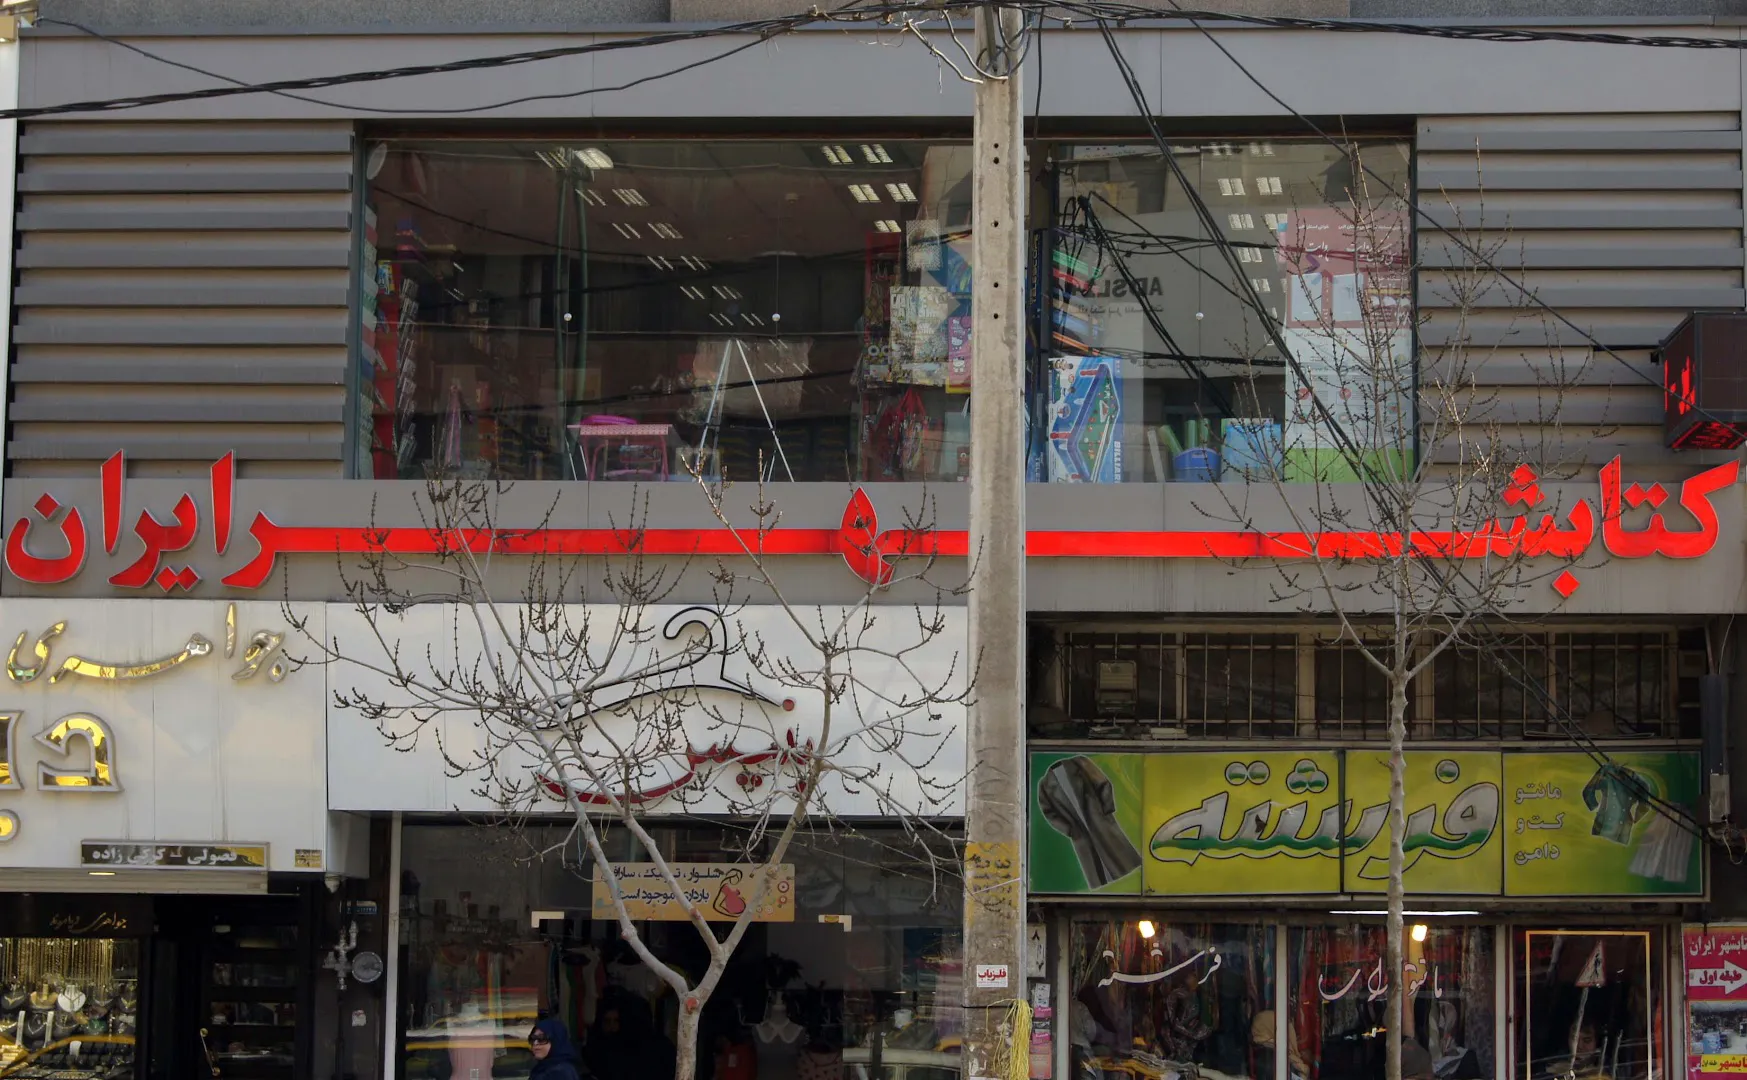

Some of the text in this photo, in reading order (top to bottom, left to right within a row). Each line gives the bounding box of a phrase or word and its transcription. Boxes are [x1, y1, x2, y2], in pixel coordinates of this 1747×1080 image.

[4, 448, 236, 593] ایران
[6, 602, 290, 684] جواهری
[1514, 781, 1562, 804] مانتو
[1149, 757, 1502, 880] فرشته
[1514, 812, 1566, 835] کت و
[1513, 841, 1561, 866] دامن
[643, 867, 681, 883] تیک
[688, 866, 722, 883] شلوار
[641, 890, 676, 904] موجود
[1688, 936, 1716, 957] ایران
[977, 968, 1007, 981] فلزیاب
[1097, 942, 1224, 989] فرشته
[1699, 968, 1743, 985] طبقه اول
